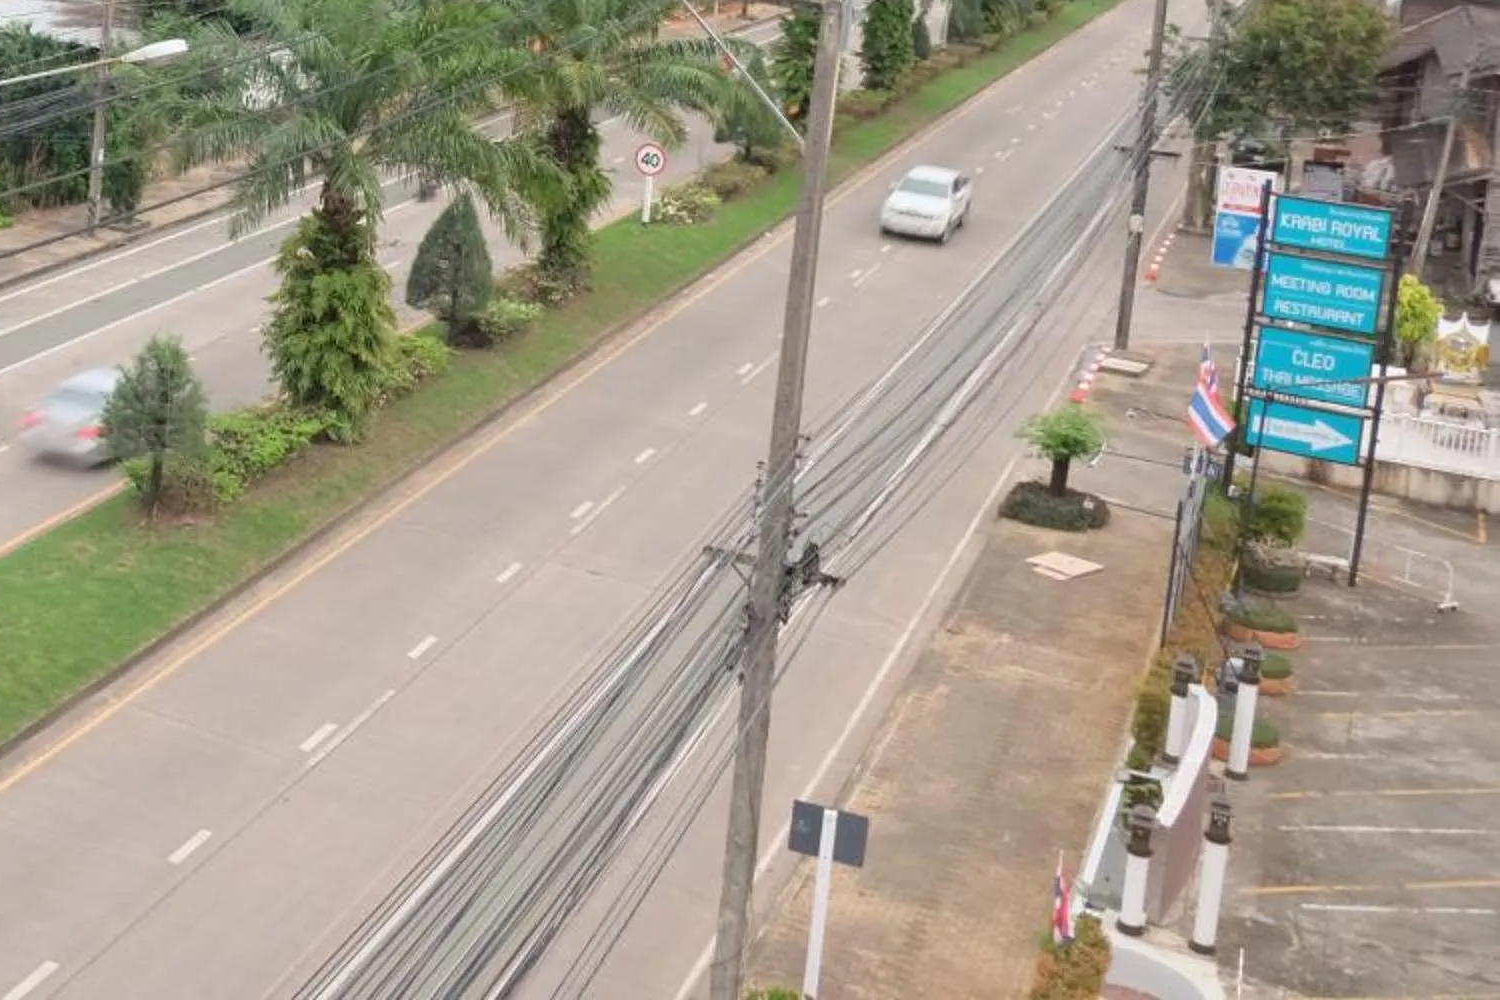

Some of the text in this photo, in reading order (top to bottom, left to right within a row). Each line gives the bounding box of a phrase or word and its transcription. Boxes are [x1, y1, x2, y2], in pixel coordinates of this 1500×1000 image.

[641, 152, 661, 168] 40
[1281, 213, 1327, 234] KRABI
[1331, 220, 1382, 242] ROYAL
[1271, 274, 1376, 303] MEETING ROOM
[1273, 298, 1365, 323] RESTAURANT
[1291, 349, 1336, 371] CLEO
[1262, 367, 1293, 386] THAI
